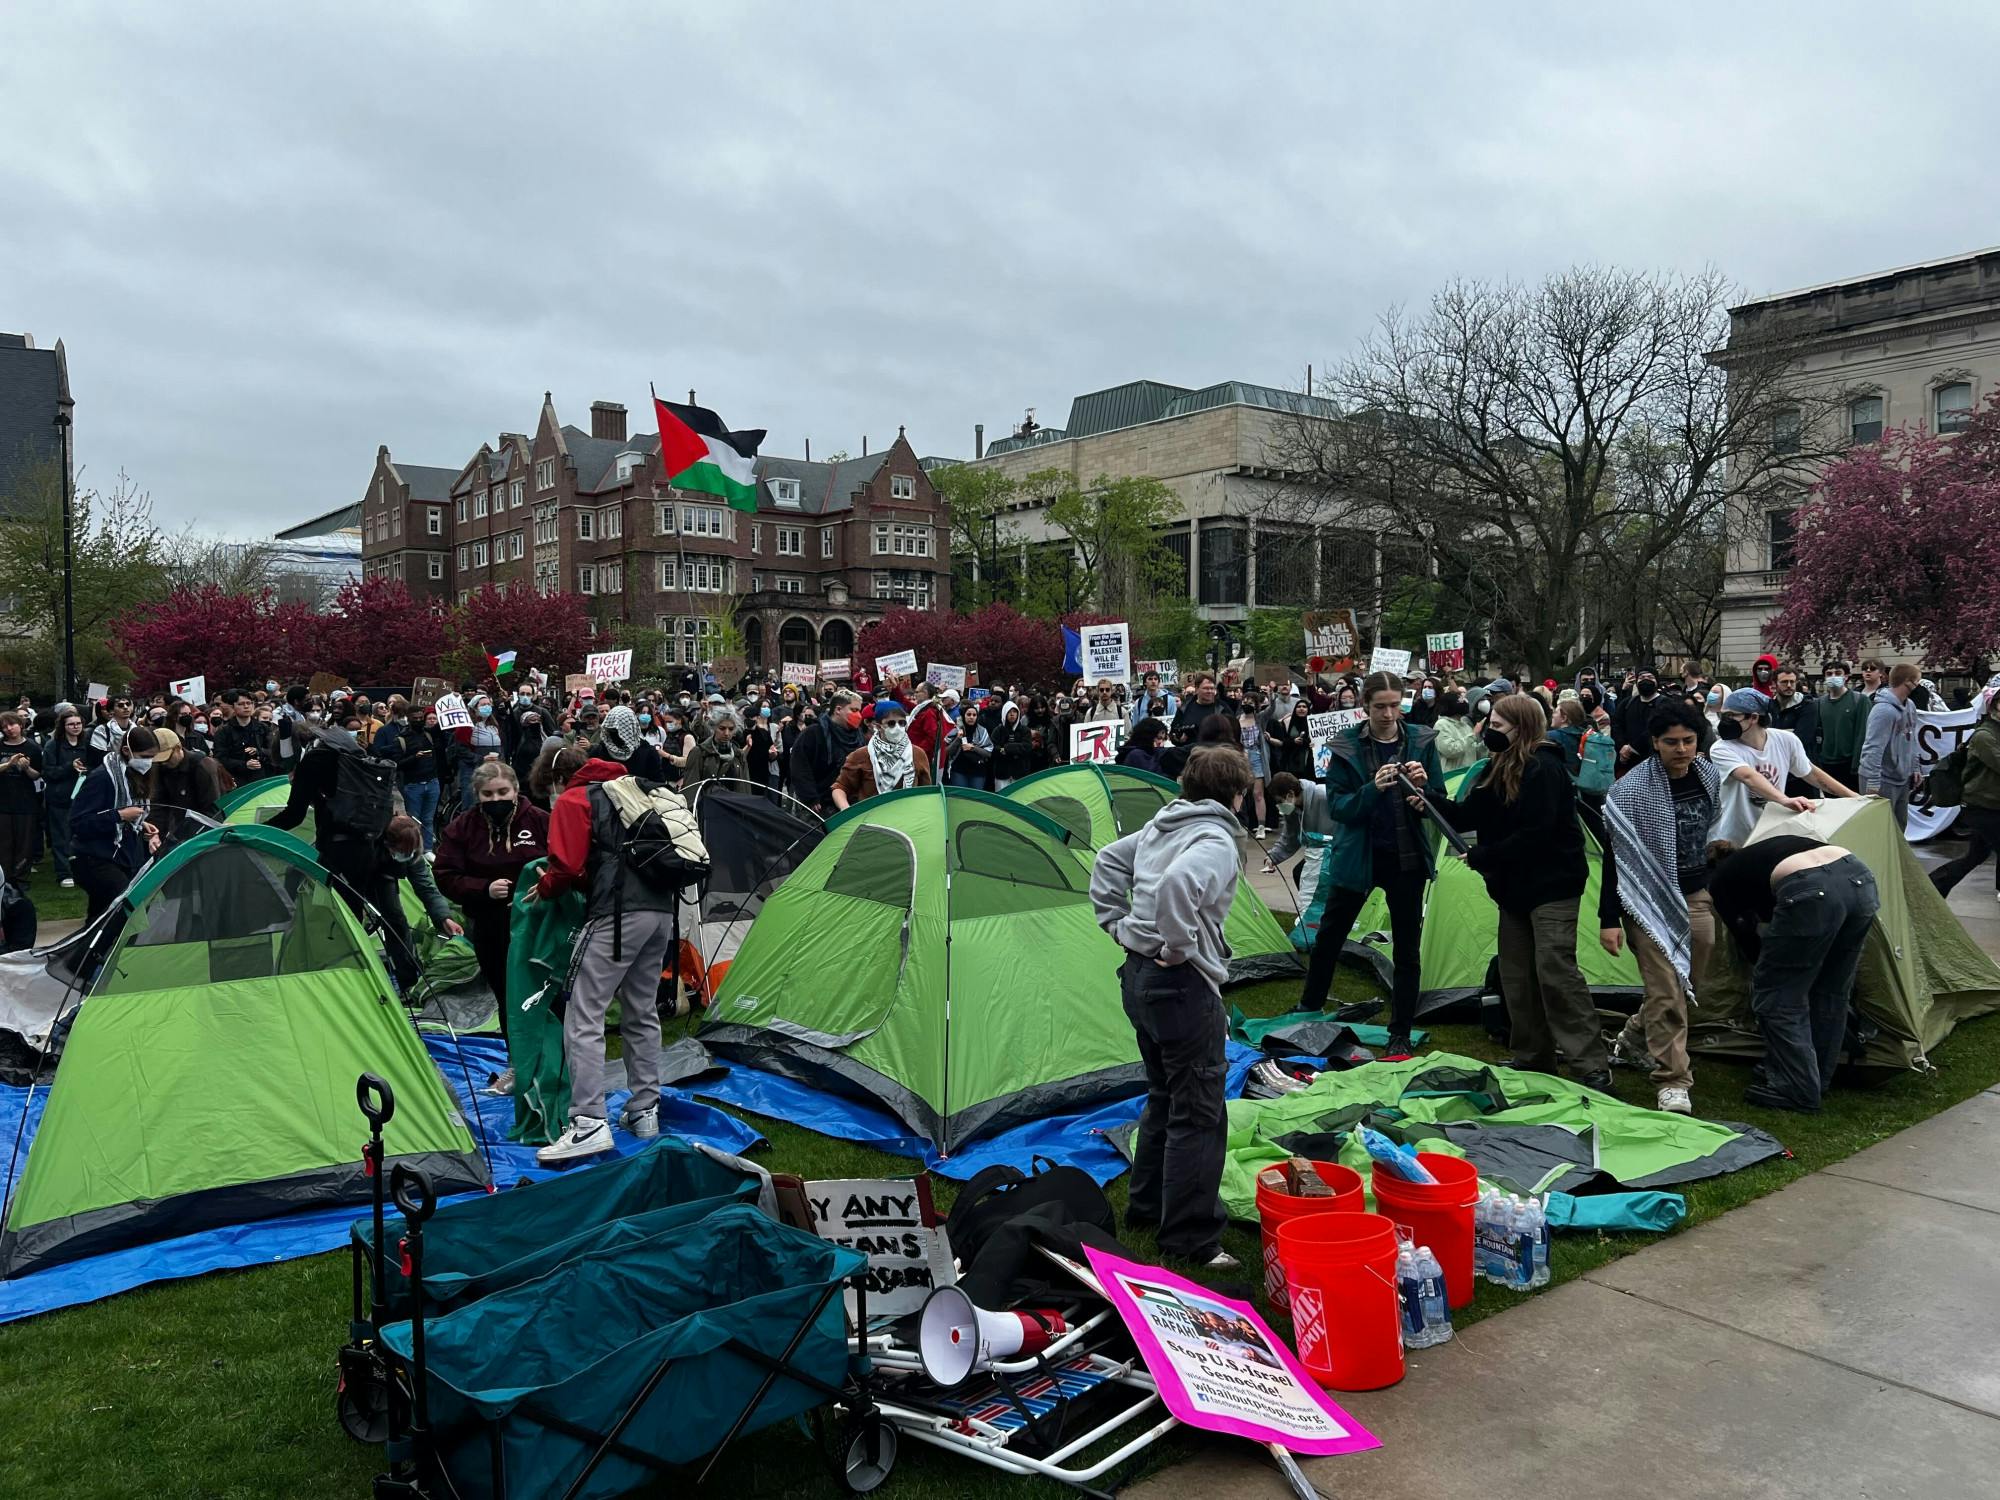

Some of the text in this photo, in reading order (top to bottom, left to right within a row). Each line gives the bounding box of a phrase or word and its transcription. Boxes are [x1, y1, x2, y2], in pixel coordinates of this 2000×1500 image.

[1318, 623, 1349, 636] WE WILL
[1313, 633, 1353, 647] LIBERATE
[1429, 635, 1458, 650] FREE
[1090, 646, 1122, 656] PALESTINE
[1313, 645, 1351, 657] THE LAND
[591, 653, 627, 668] FIGHT
[1098, 662, 1116, 670] FREE!
[1137, 661, 1170, 672] RIGHT TO
[1309, 714, 1339, 728] THERE
[1340, 712, 1349, 723] IS
[841, 1193, 916, 1219] ANY
[1483, 1238, 1514, 1256] MOUNTAIN
[1156, 1304, 1190, 1324] SAVE
[1151, 1314, 1199, 1340] RAFAH!
[1167, 1340, 1294, 1387] Stop U.S.-Israel
[1200, 1365, 1282, 1398] Genocide!
[1193, 1382, 1325, 1424] wibailoutpeople.org
